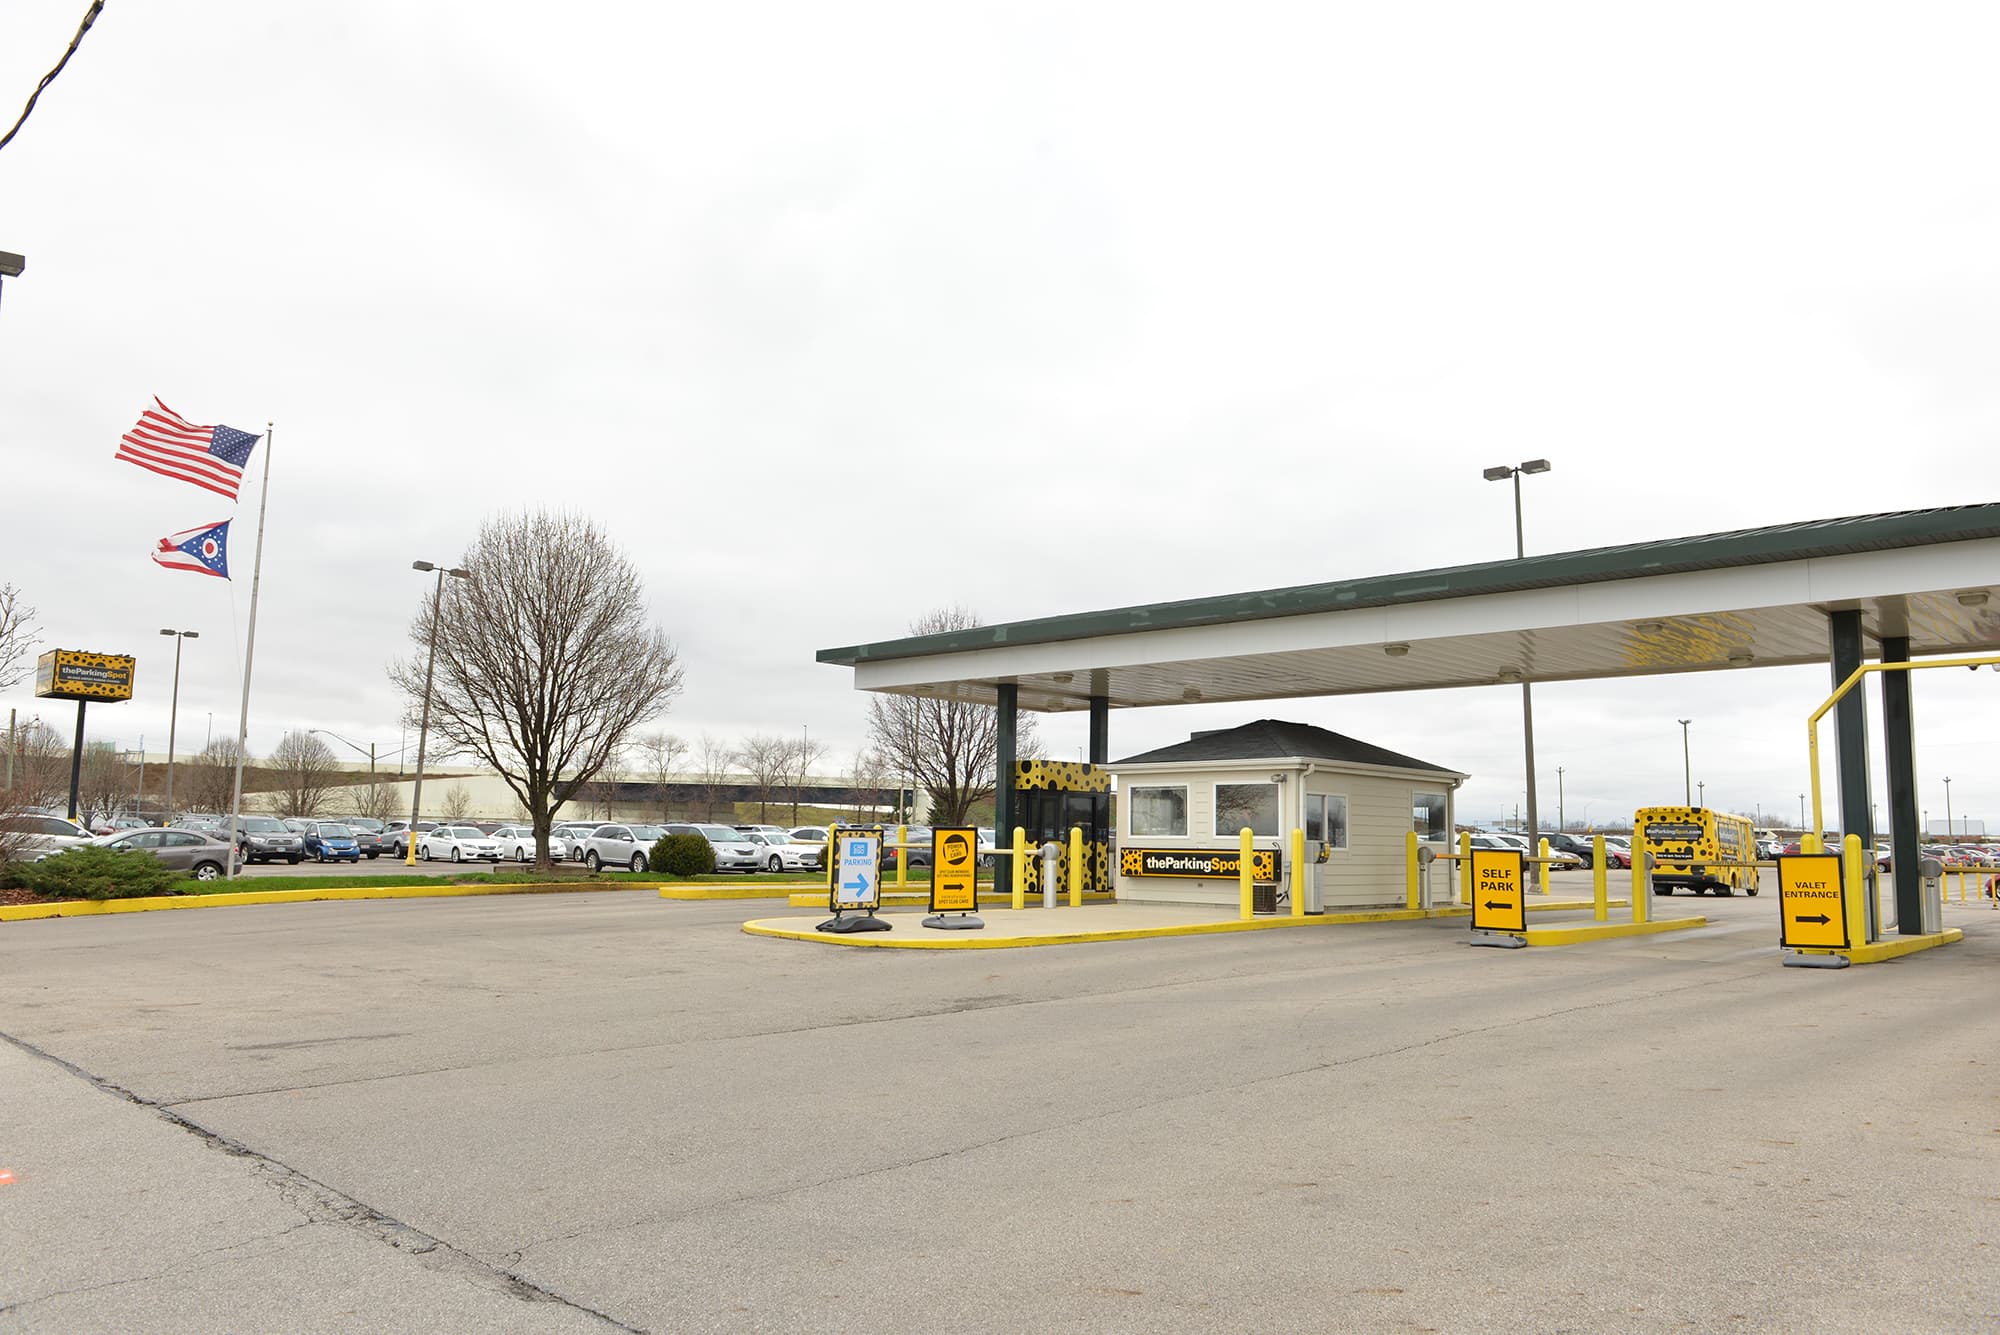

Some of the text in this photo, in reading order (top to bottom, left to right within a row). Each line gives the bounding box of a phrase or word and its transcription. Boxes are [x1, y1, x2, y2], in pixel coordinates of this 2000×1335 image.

[62, 666, 127, 680] theParkingSpot
[843, 858, 873, 867] PARKING
[1146, 856, 1241, 873] theParkingSpot
[1482, 868, 1512, 879] SELF
[1480, 881, 1514, 892] PARK
[1794, 881, 1827, 889] VALET
[1784, 890, 1839, 899] ENTRANCE
